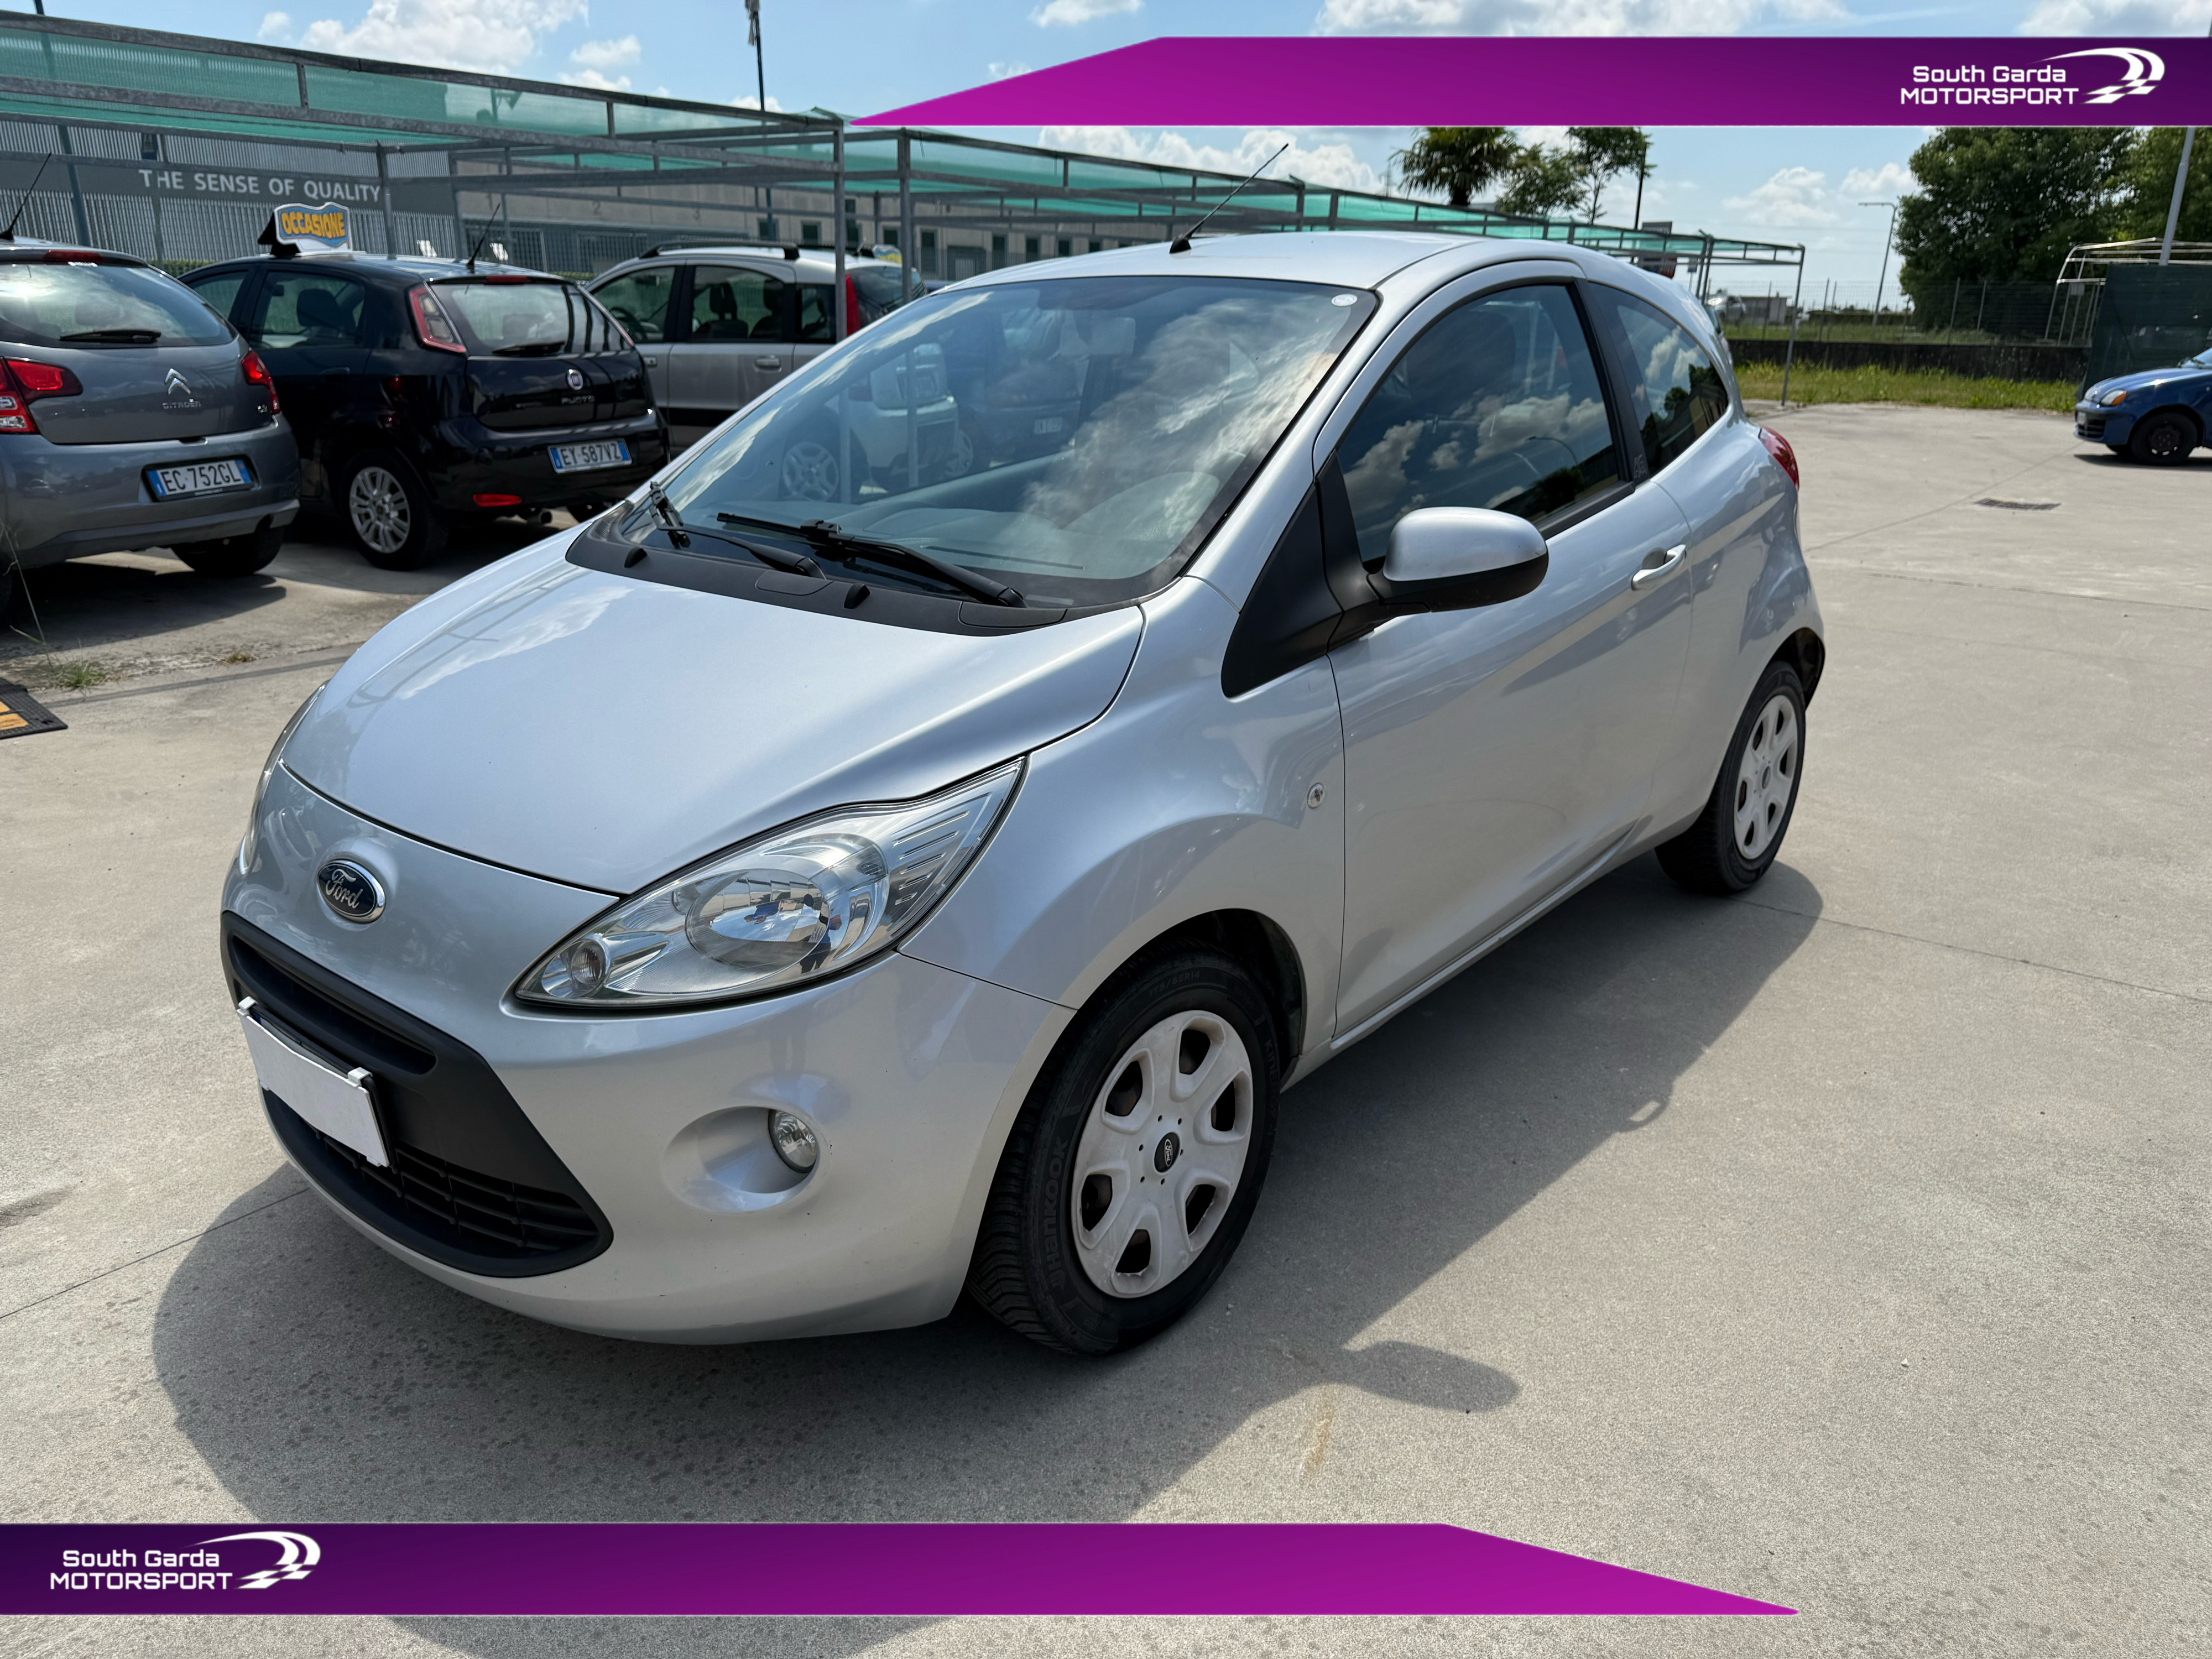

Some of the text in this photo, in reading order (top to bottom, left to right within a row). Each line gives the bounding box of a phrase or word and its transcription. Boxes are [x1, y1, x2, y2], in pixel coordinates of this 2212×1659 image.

[138, 169, 380, 202] THE SENSE OF QUALITY
[281, 211, 346, 239] OCCASIONE
[559, 444, 621, 466] EY 587VZ
[160, 469, 186, 492] EC
[186, 462, 241, 488] 752GL
[325, 868, 364, 909] Ford
